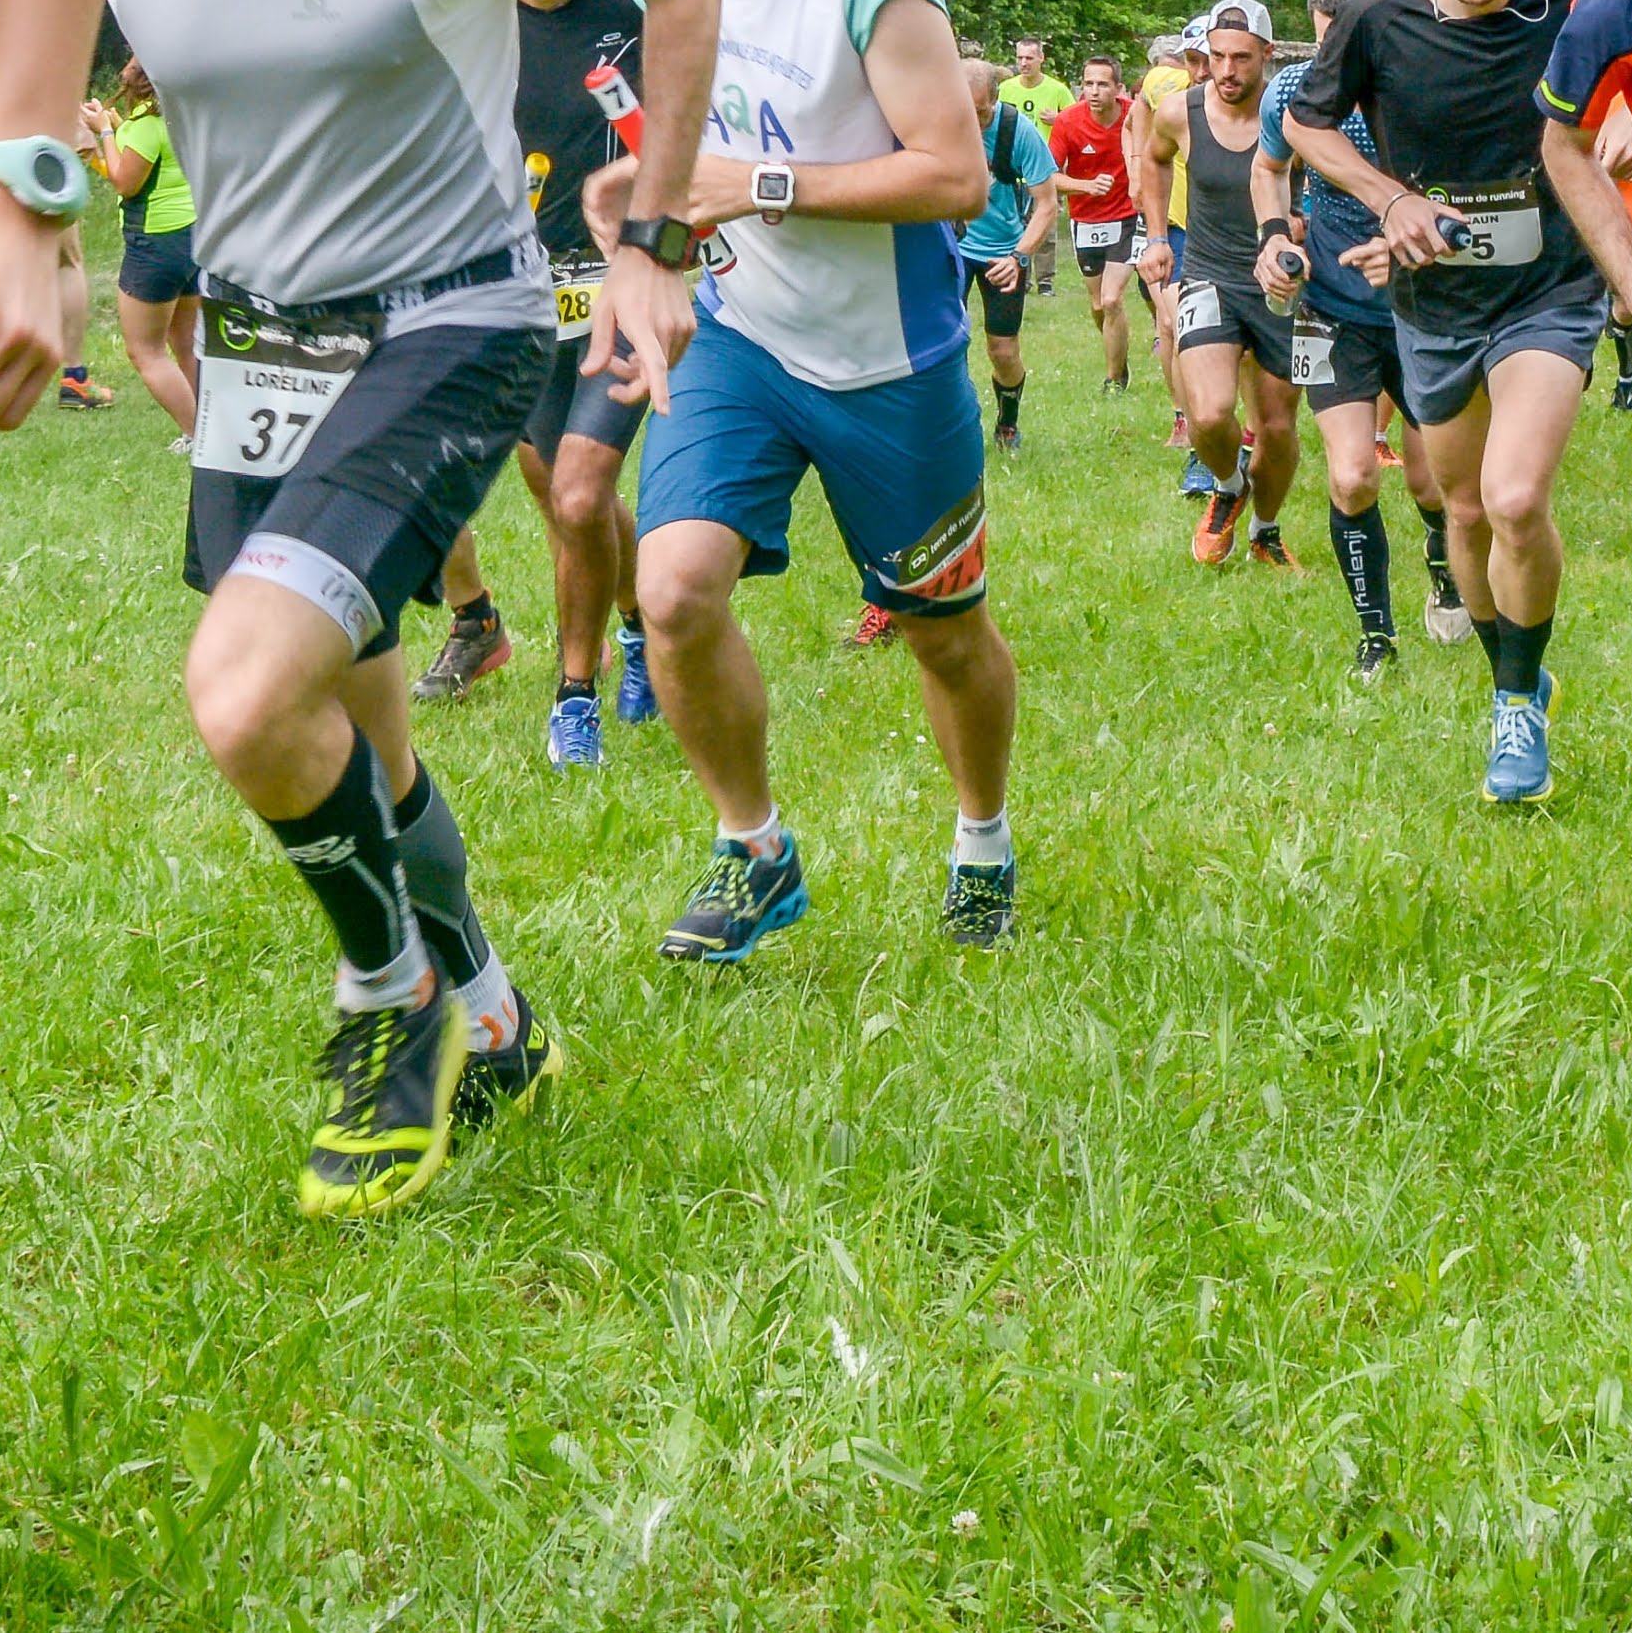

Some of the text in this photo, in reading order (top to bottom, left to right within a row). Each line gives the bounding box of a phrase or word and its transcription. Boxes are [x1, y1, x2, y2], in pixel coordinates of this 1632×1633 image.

[1451, 194, 1473, 204] terre
[1476, 193, 1487, 203] de
[1489, 189, 1525, 202] running
[1468, 215, 1499, 225] AUN
[1090, 232, 1109, 244] 92
[558, 290, 591, 324] 28
[1293, 354, 1311, 379] 86
[244, 369, 335, 397] LORELINE
[240, 407, 314, 464] 37
